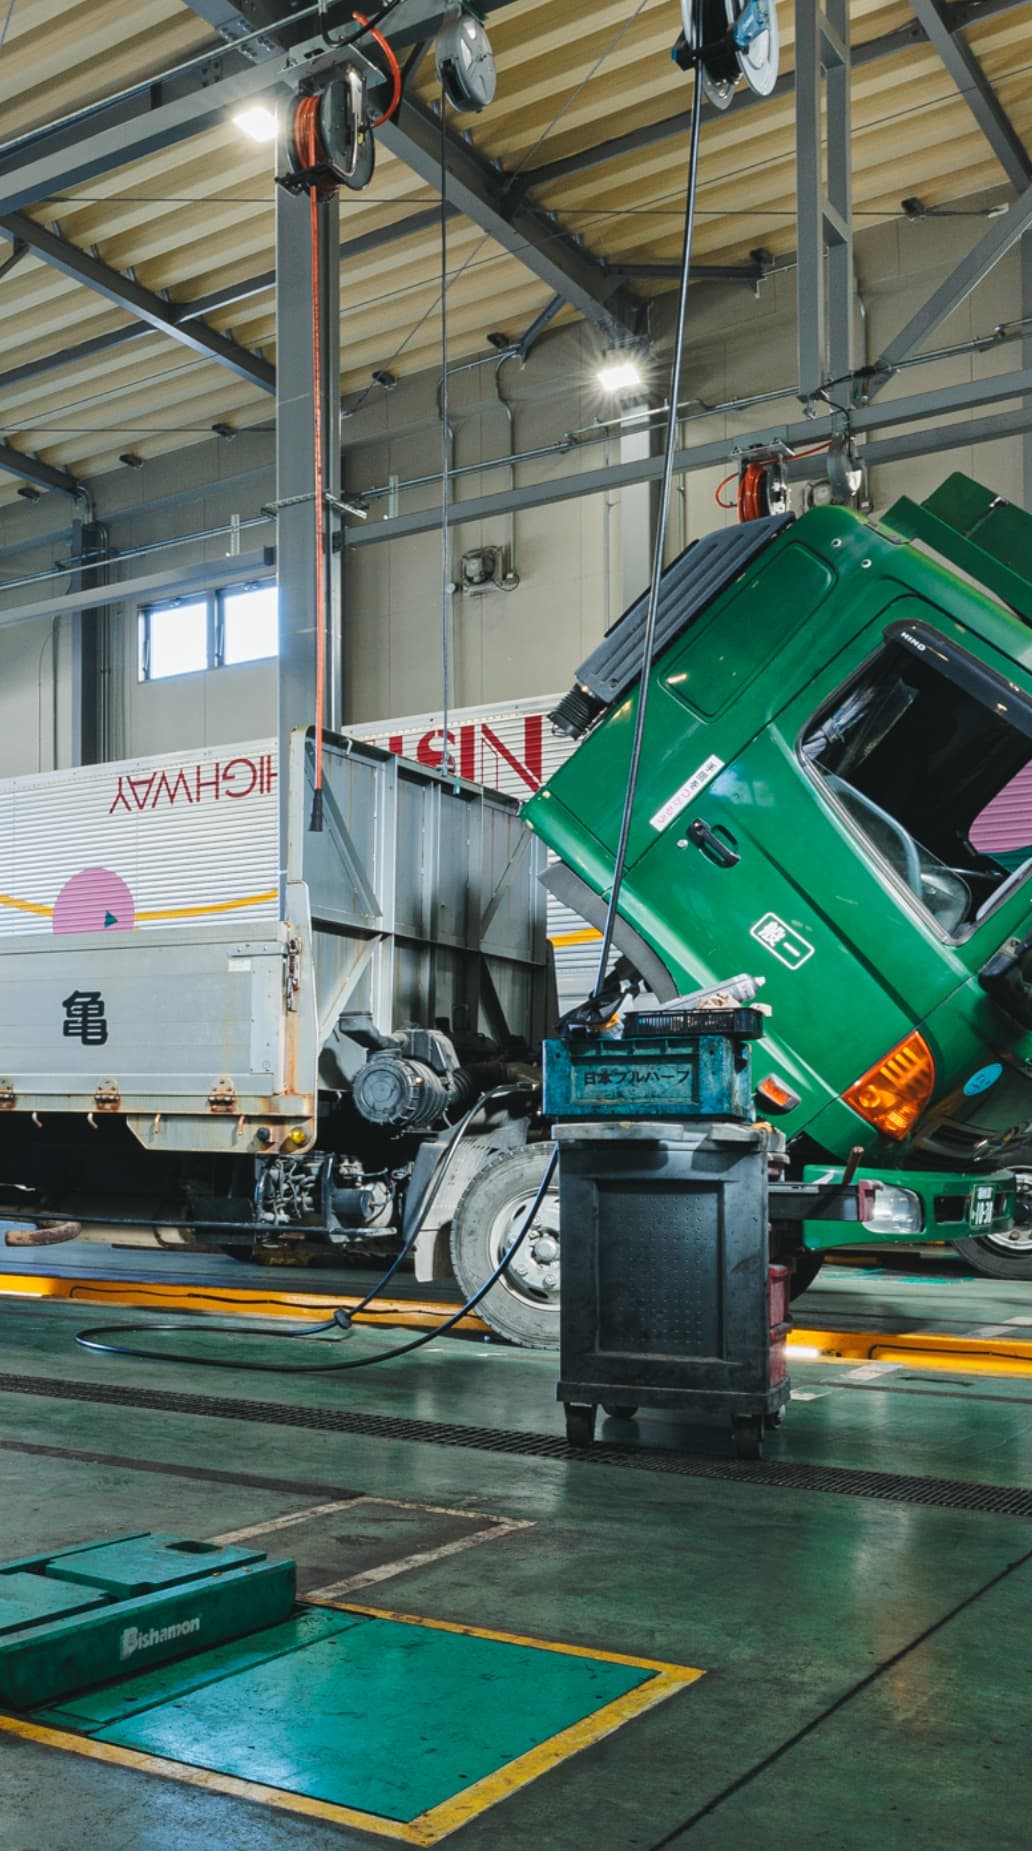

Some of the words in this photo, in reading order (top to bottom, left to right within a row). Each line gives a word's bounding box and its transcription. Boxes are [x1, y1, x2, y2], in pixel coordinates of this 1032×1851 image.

[900, 631, 927, 652] HINO
[62, 990, 108, 1046] 亀
[584, 1067, 690, 1087] 日本フルハーフ
[121, 1617, 201, 1659] Bishamon
